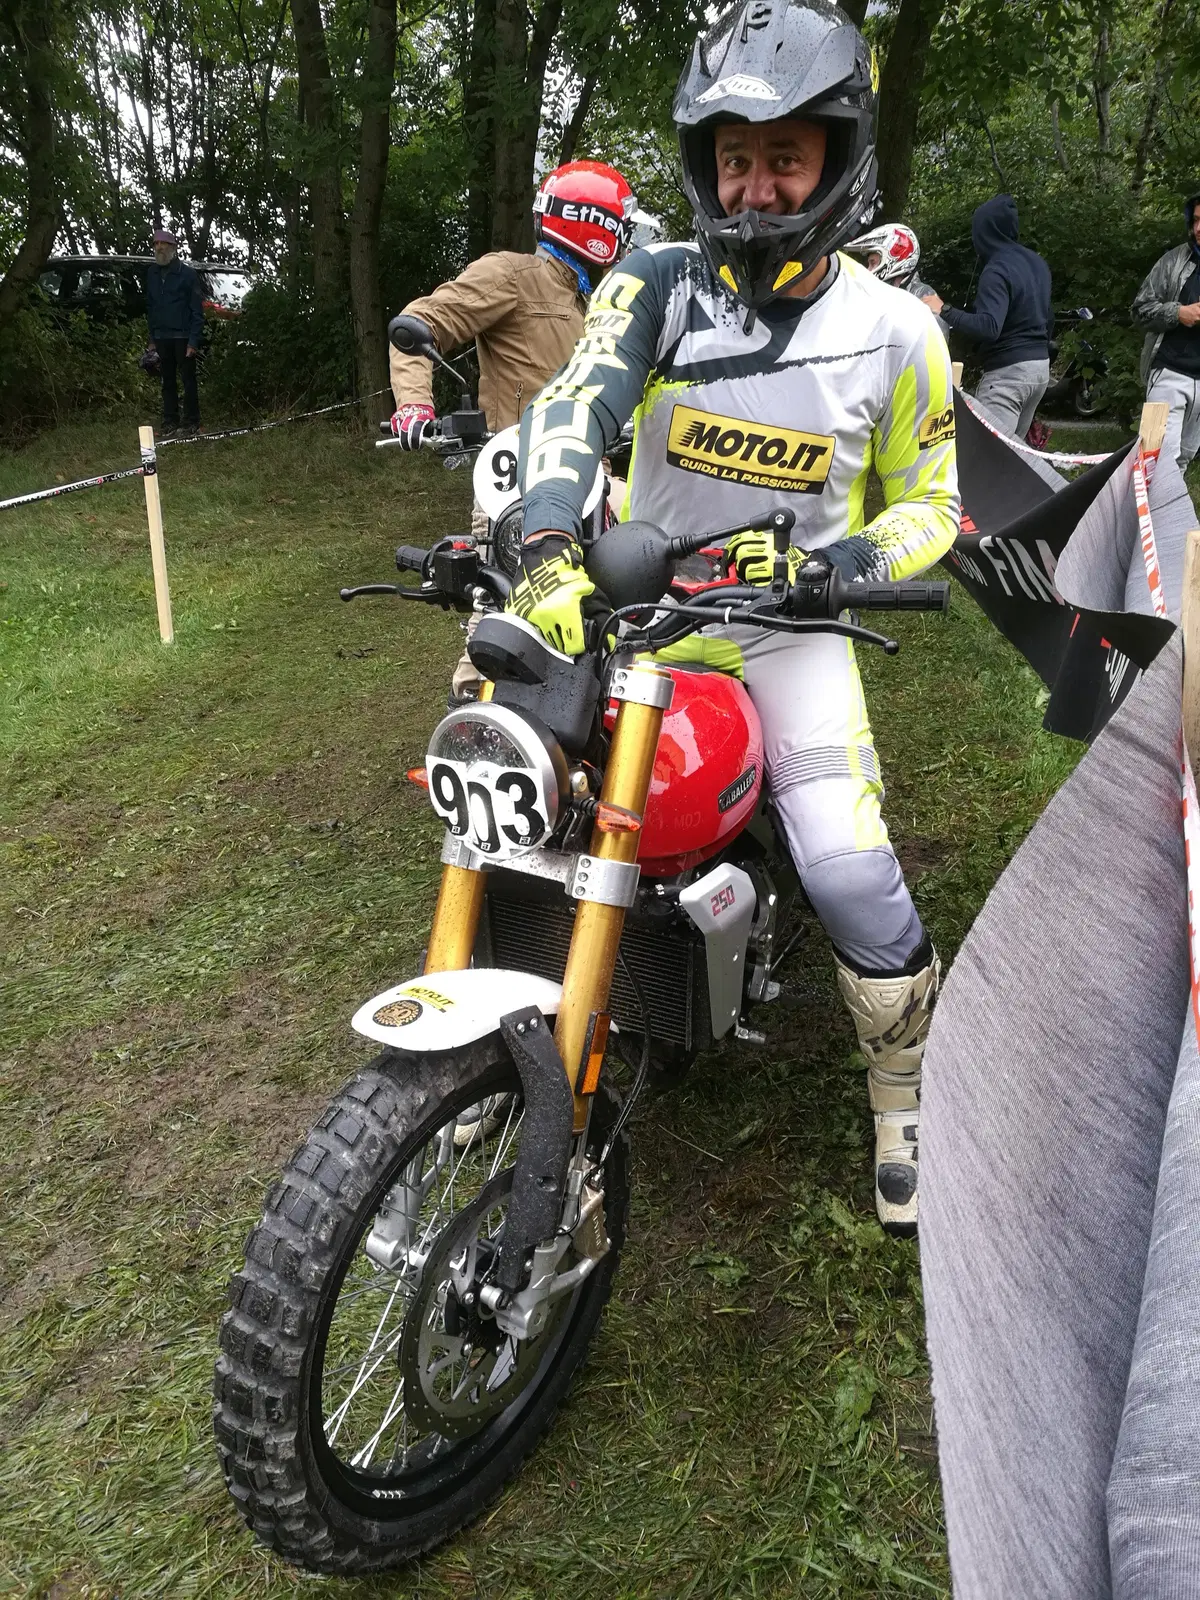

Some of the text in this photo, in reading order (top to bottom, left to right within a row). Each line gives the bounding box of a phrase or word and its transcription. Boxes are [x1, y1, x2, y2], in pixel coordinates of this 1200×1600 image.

[678, 420, 828, 472] MOTO.IT
[491, 449, 518, 493] 9
[679, 457, 811, 492] GUIDA LA PASSIONE
[431, 763, 546, 854] 903
[710, 884, 736, 917] 250
[864, 988, 922, 1054] TCX
